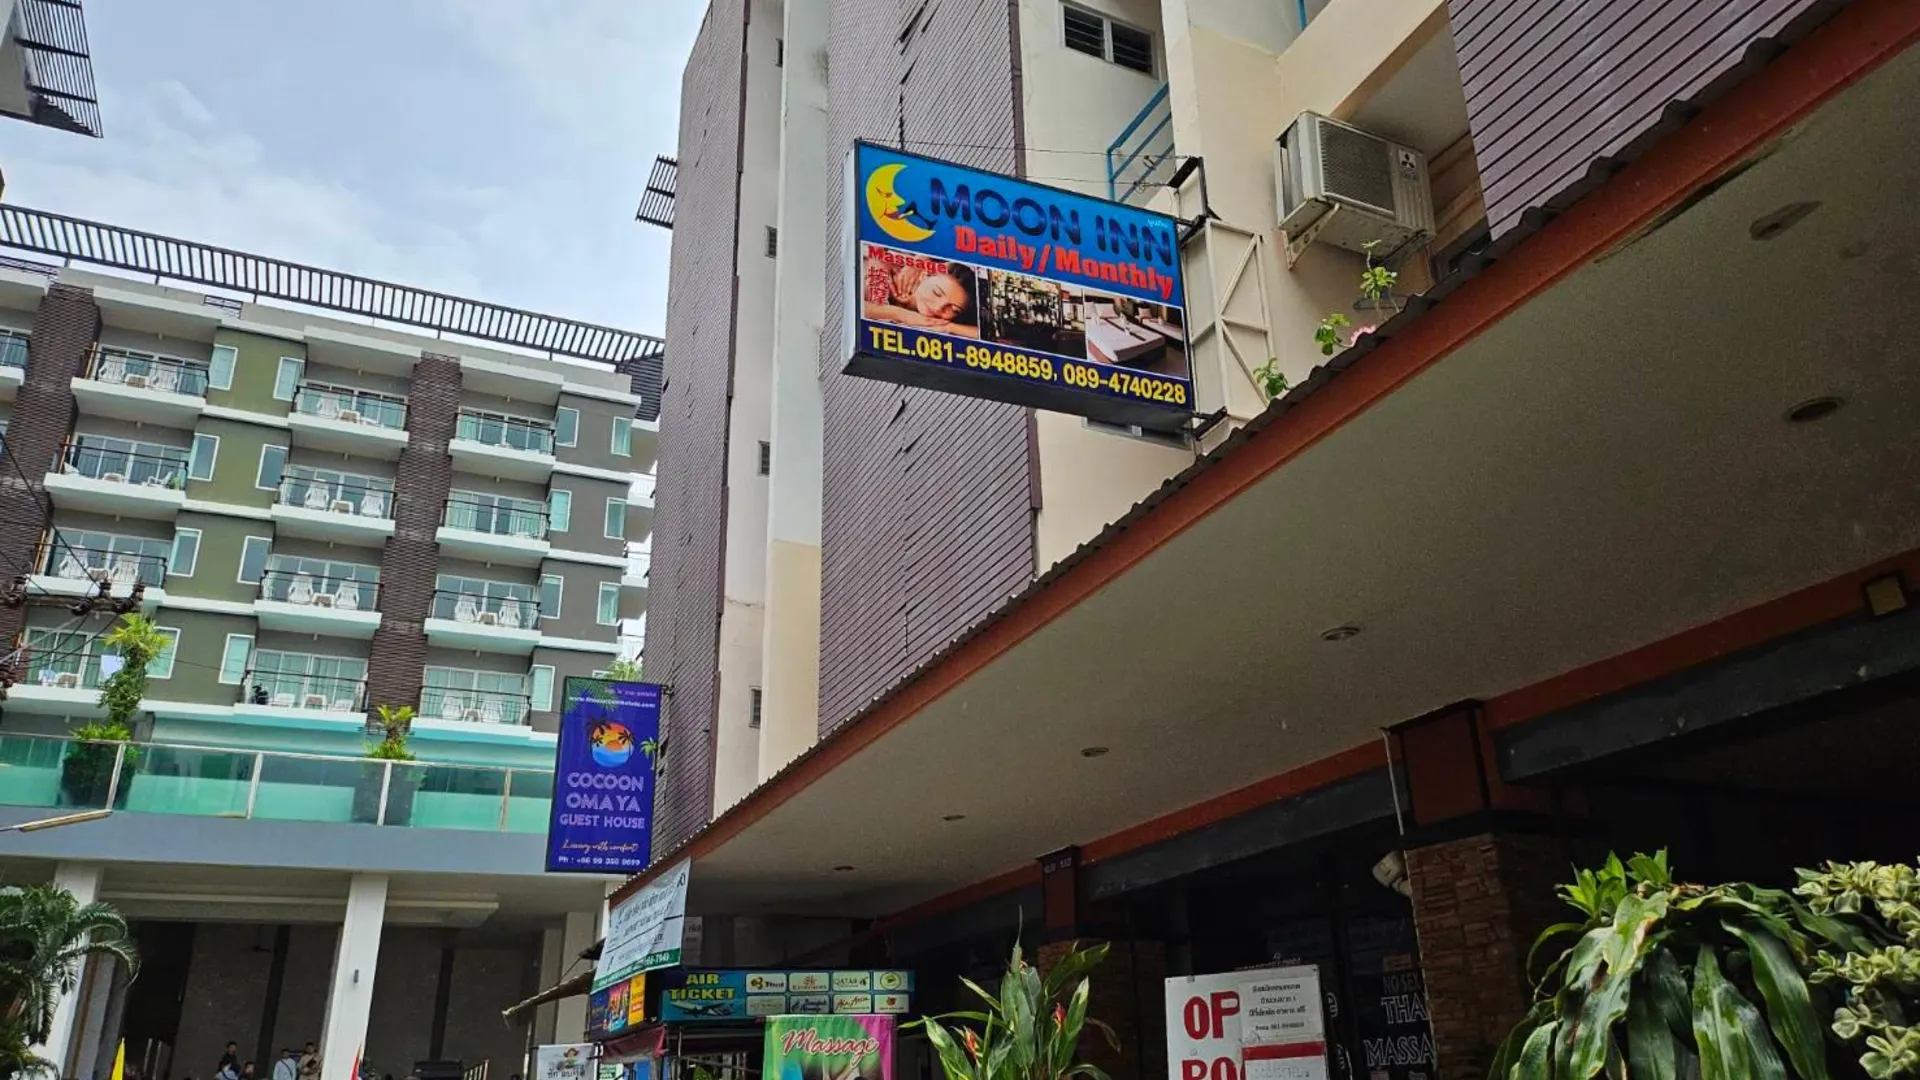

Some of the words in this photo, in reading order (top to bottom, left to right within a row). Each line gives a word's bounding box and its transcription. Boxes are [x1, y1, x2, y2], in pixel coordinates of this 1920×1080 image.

[929, 178, 1081, 246] MOON
[1096, 214, 1173, 267] INN
[868, 246, 947, 274] Massage
[1062, 363, 1188, 405] 089-4740228
[567, 772, 645, 791] COCOON
[559, 813, 600, 827] GUEST
[604, 815, 646, 829] HOUSE
[686, 973, 720, 985] AIR
[670, 988, 736, 1000] TICKET
[780, 1027, 880, 1068] Massage
